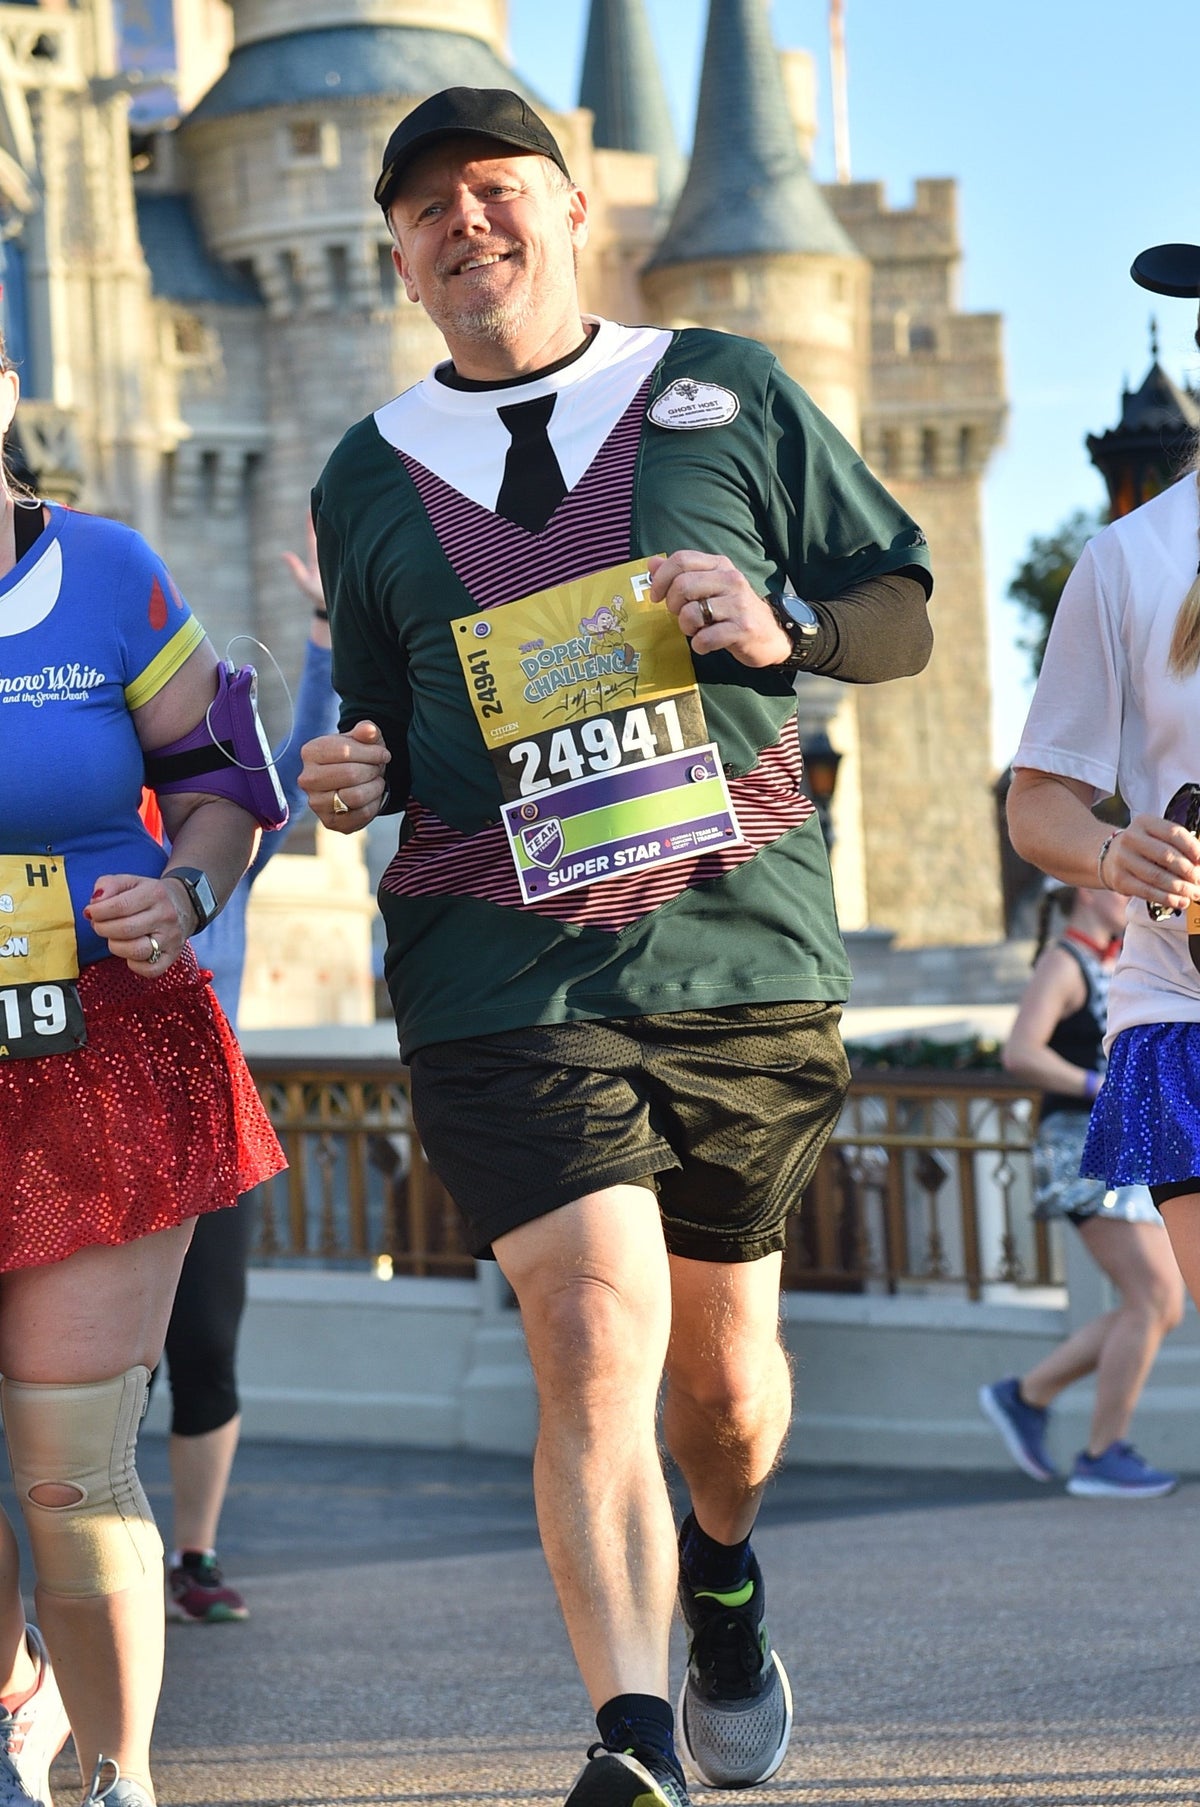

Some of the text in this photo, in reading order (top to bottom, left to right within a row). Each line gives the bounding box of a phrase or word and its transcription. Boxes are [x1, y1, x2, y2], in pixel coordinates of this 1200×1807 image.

[668, 404, 697, 416] GHOST
[698, 400, 719, 409] HOST
[520, 636, 593, 681] DOPEY
[0, 663, 106, 693] now White
[2, 684, 89, 708] and the Seven Dwarfs
[467, 649, 504, 719] 24941
[524, 653, 641, 704] CHALLENGE
[490, 721, 519, 737] CITIZEN
[508, 700, 685, 797] 24941
[528, 822, 558, 852] TEAM
[25, 863, 49, 887] H
[547, 841, 661, 887] SUPER STAR
[0, 984, 67, 1040] 19
